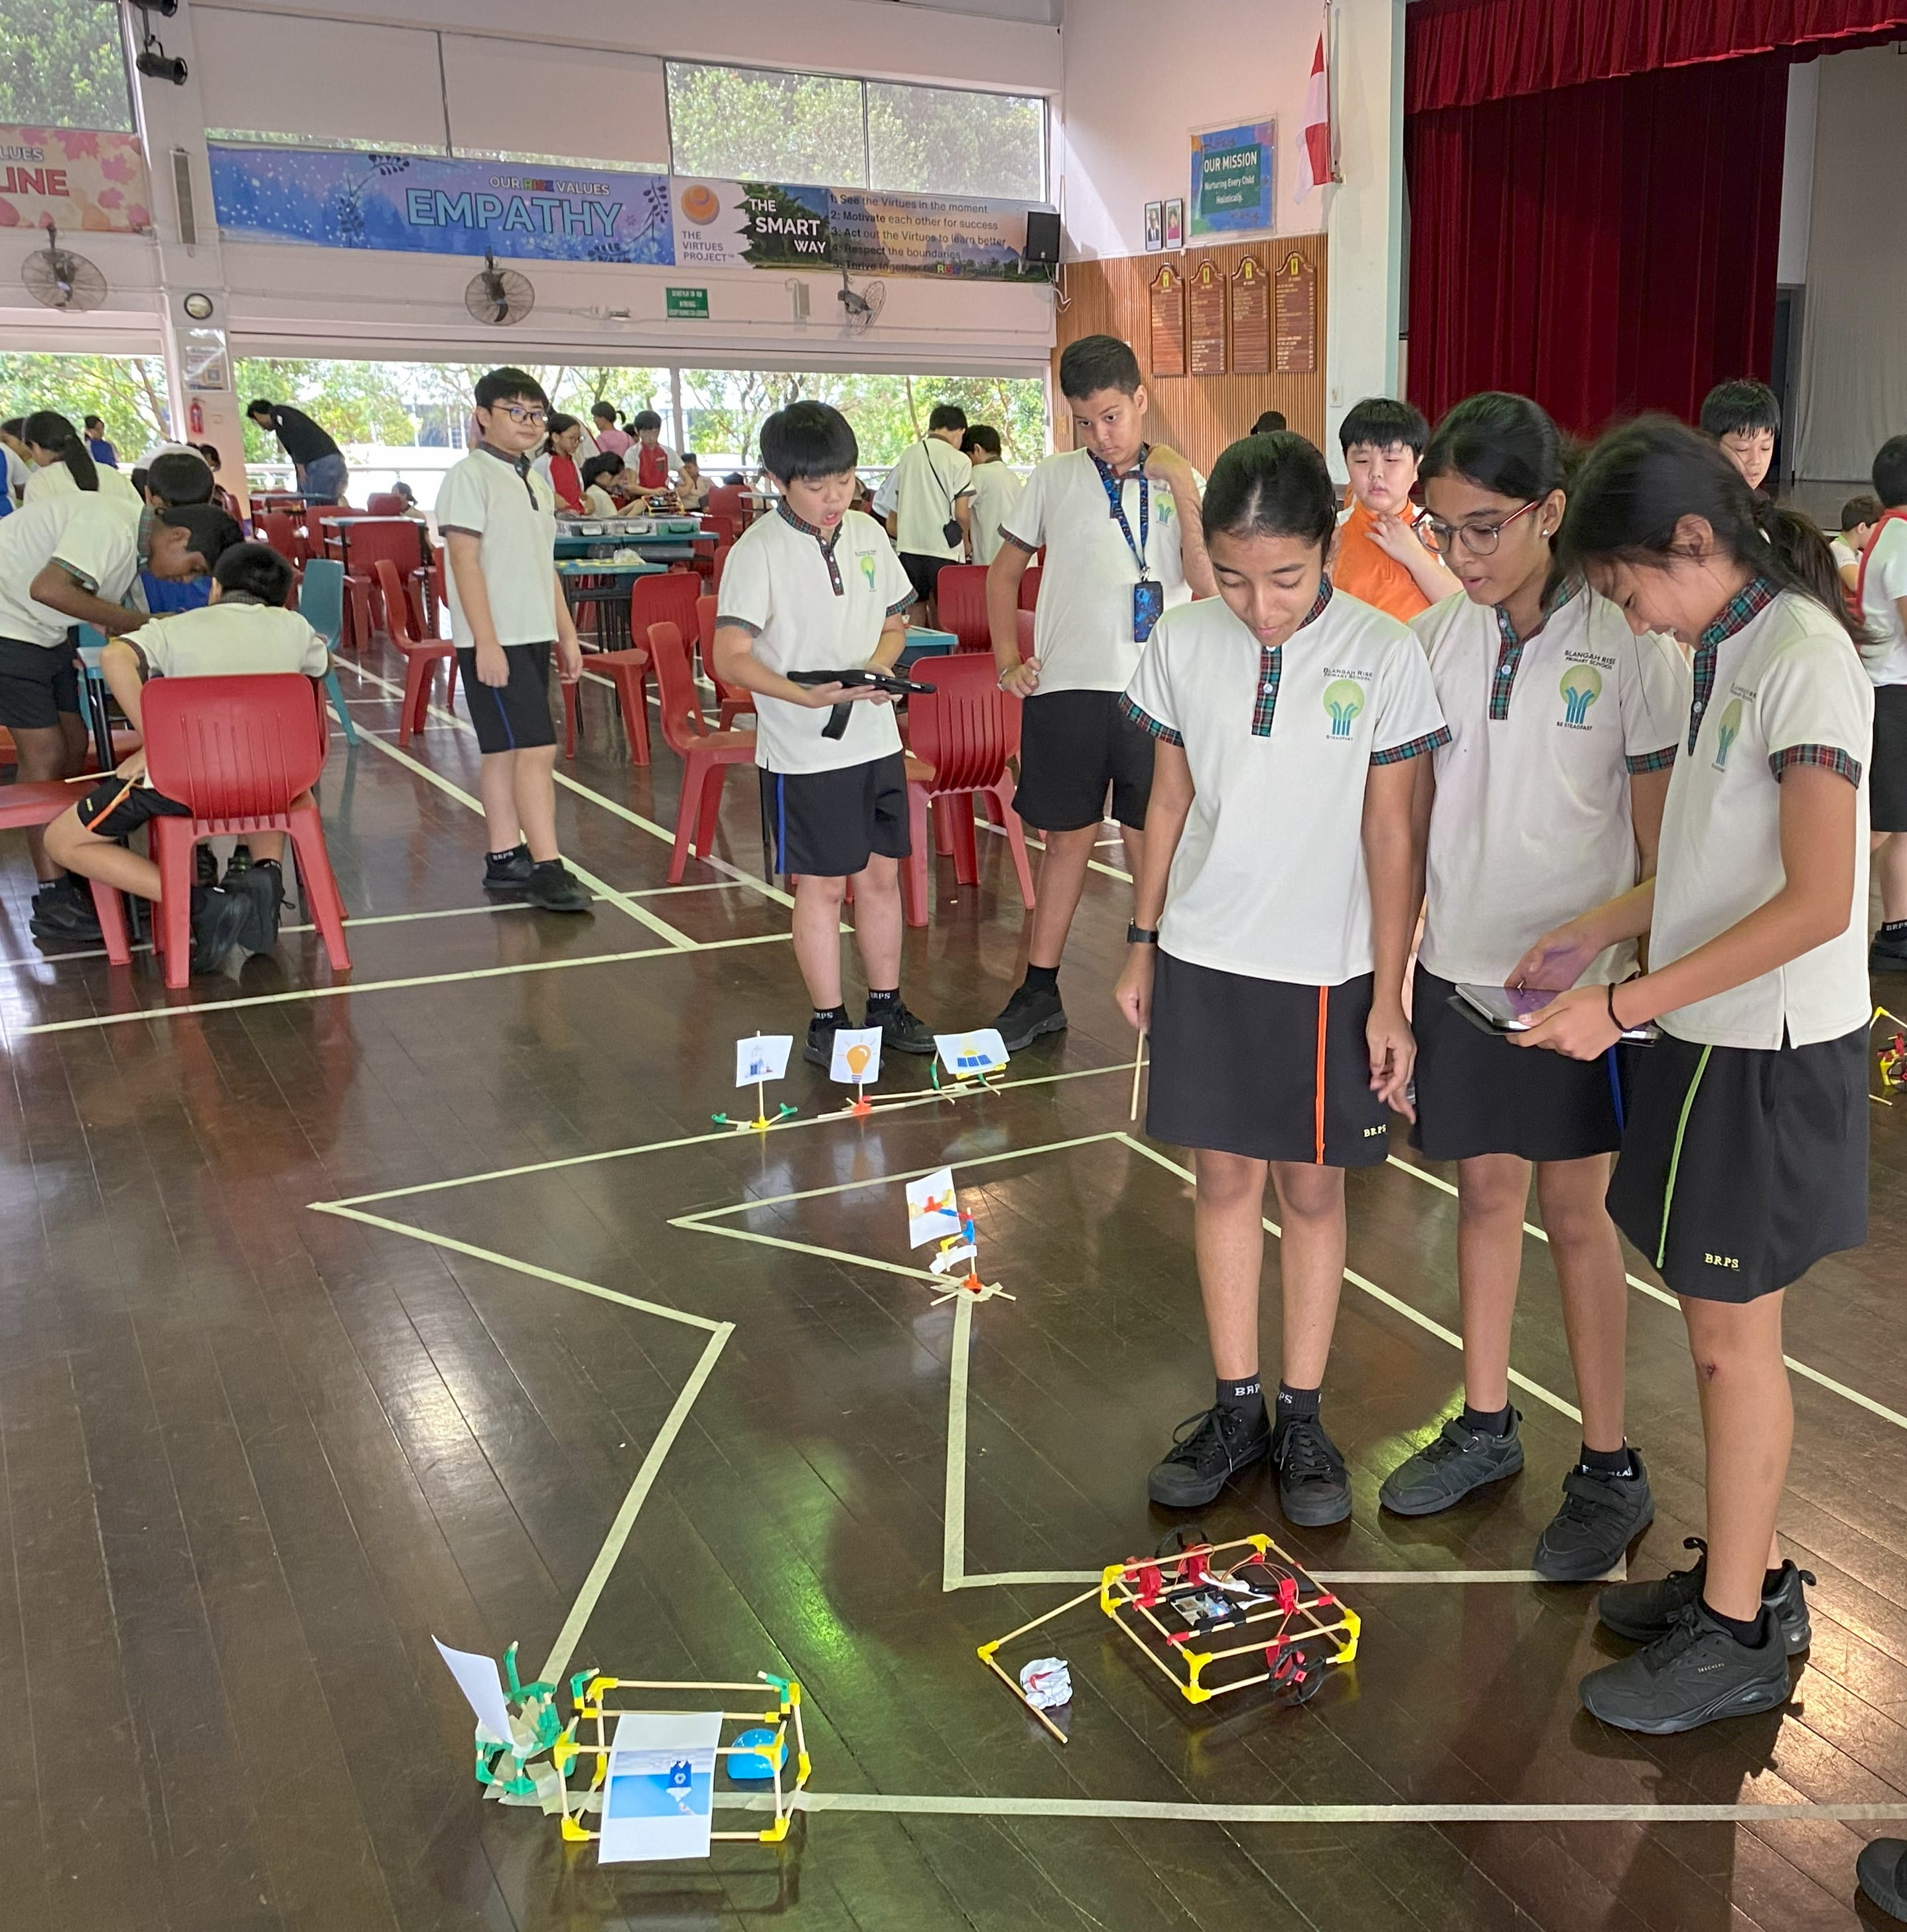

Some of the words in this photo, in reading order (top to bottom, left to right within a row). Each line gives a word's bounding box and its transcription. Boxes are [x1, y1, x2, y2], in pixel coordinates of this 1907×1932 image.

[1204, 157, 1221, 172] OUR
[1222, 151, 1257, 170] MISSION
[490, 175, 521, 190] OUR
[557, 180, 610, 196] VALUES
[1204, 180, 1227, 190] Nurturing
[1228, 178, 1241, 187] Every
[1241, 174, 1255, 184] Child
[748, 198, 776, 212] THE
[840, 194, 859, 204] See
[863, 196, 878, 206] the
[881, 197, 916, 208] Virtues
[919, 200, 928, 209] in
[931, 201, 946, 210] the
[949, 203, 987, 213] moment
[405, 188, 623, 238] EMPATHY
[831, 210, 840, 220] 2:
[843, 211, 885, 222] Motivate
[888, 215, 912, 224] each
[915, 217, 940, 226] other
[944, 218, 957, 227] for
[959, 220, 998, 230] success
[755, 216, 820, 236] SMART
[681, 230, 701, 240] THE
[831, 226, 841, 236] 3:
[844, 228, 861, 237] Act
[863, 230, 879, 239] out
[883, 230, 898, 240] the
[902, 231, 937, 242] Virtues
[939, 232, 948, 242] to
[952, 232, 975, 243] learn
[977, 236, 1006, 246] better
[682, 241, 723, 251] VIRTUES
[794, 239, 826, 253] WAY
[845, 243, 885, 255] Respect
[888, 247, 904, 256] the
[906, 247, 961, 259] boundaries
[1565, 650, 1600, 661] BLANGAH
[1364, 1124, 1386, 1137] BRPS
[1704, 1253, 1739, 1269] BRPS
